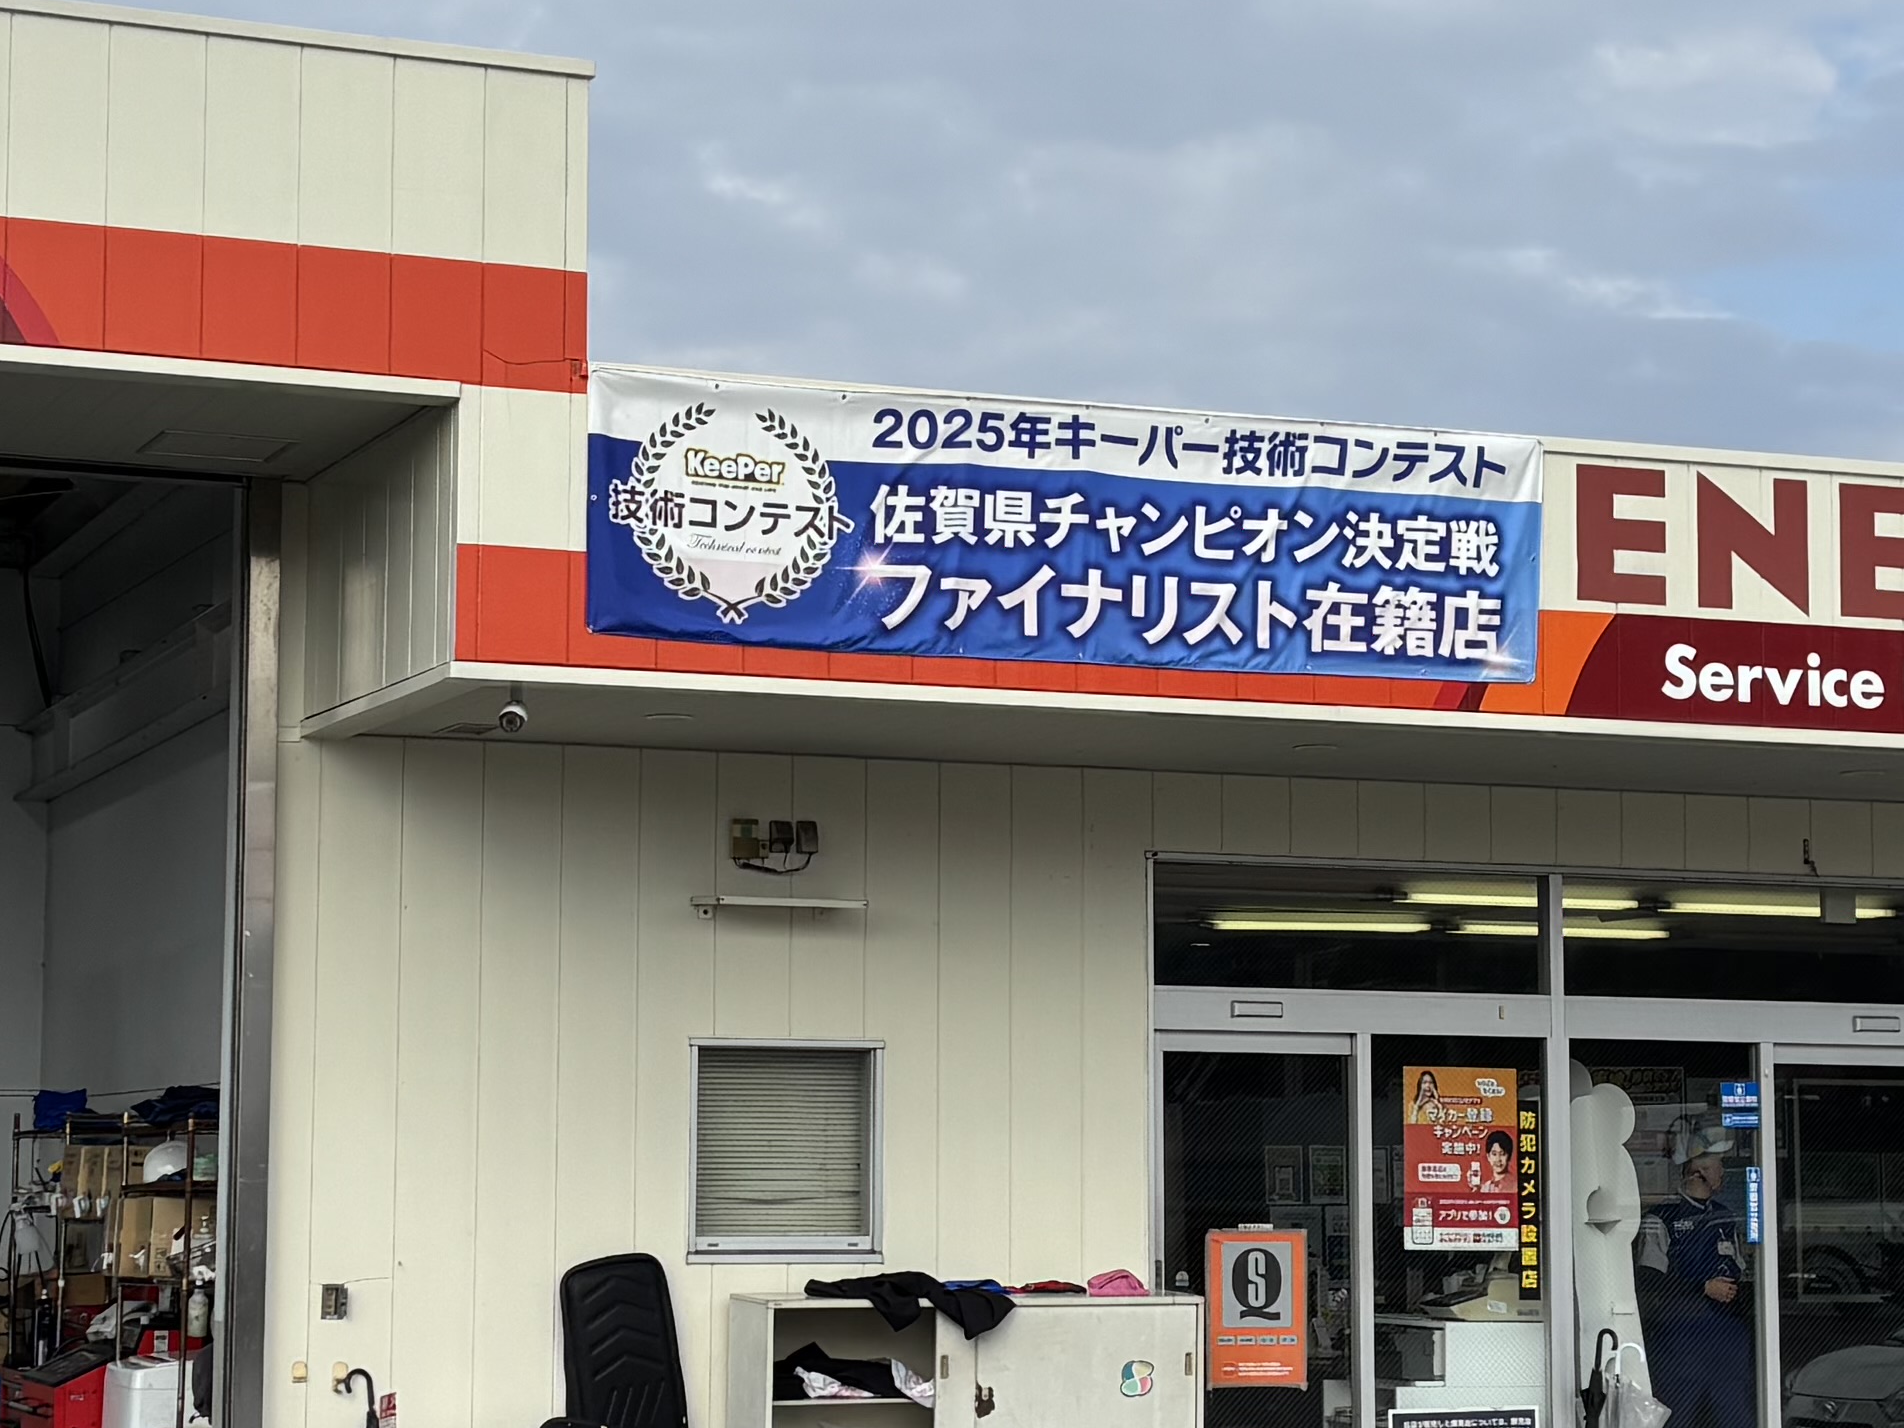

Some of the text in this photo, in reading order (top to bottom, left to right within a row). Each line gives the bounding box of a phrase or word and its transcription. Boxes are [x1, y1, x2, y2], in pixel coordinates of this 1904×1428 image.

[684, 447, 785, 484] KeePer
[871, 406, 1508, 490] 2025年キーパー技術コンテスト
[611, 481, 854, 540] 技術コンテスト
[870, 485, 1500, 578] 佐賀県チャンピオン決定戦
[874, 569, 1503, 660] ファイナリスト在籍店
[1660, 642, 1885, 712] Service
[1433, 1125, 1488, 1138] キャンペーン
